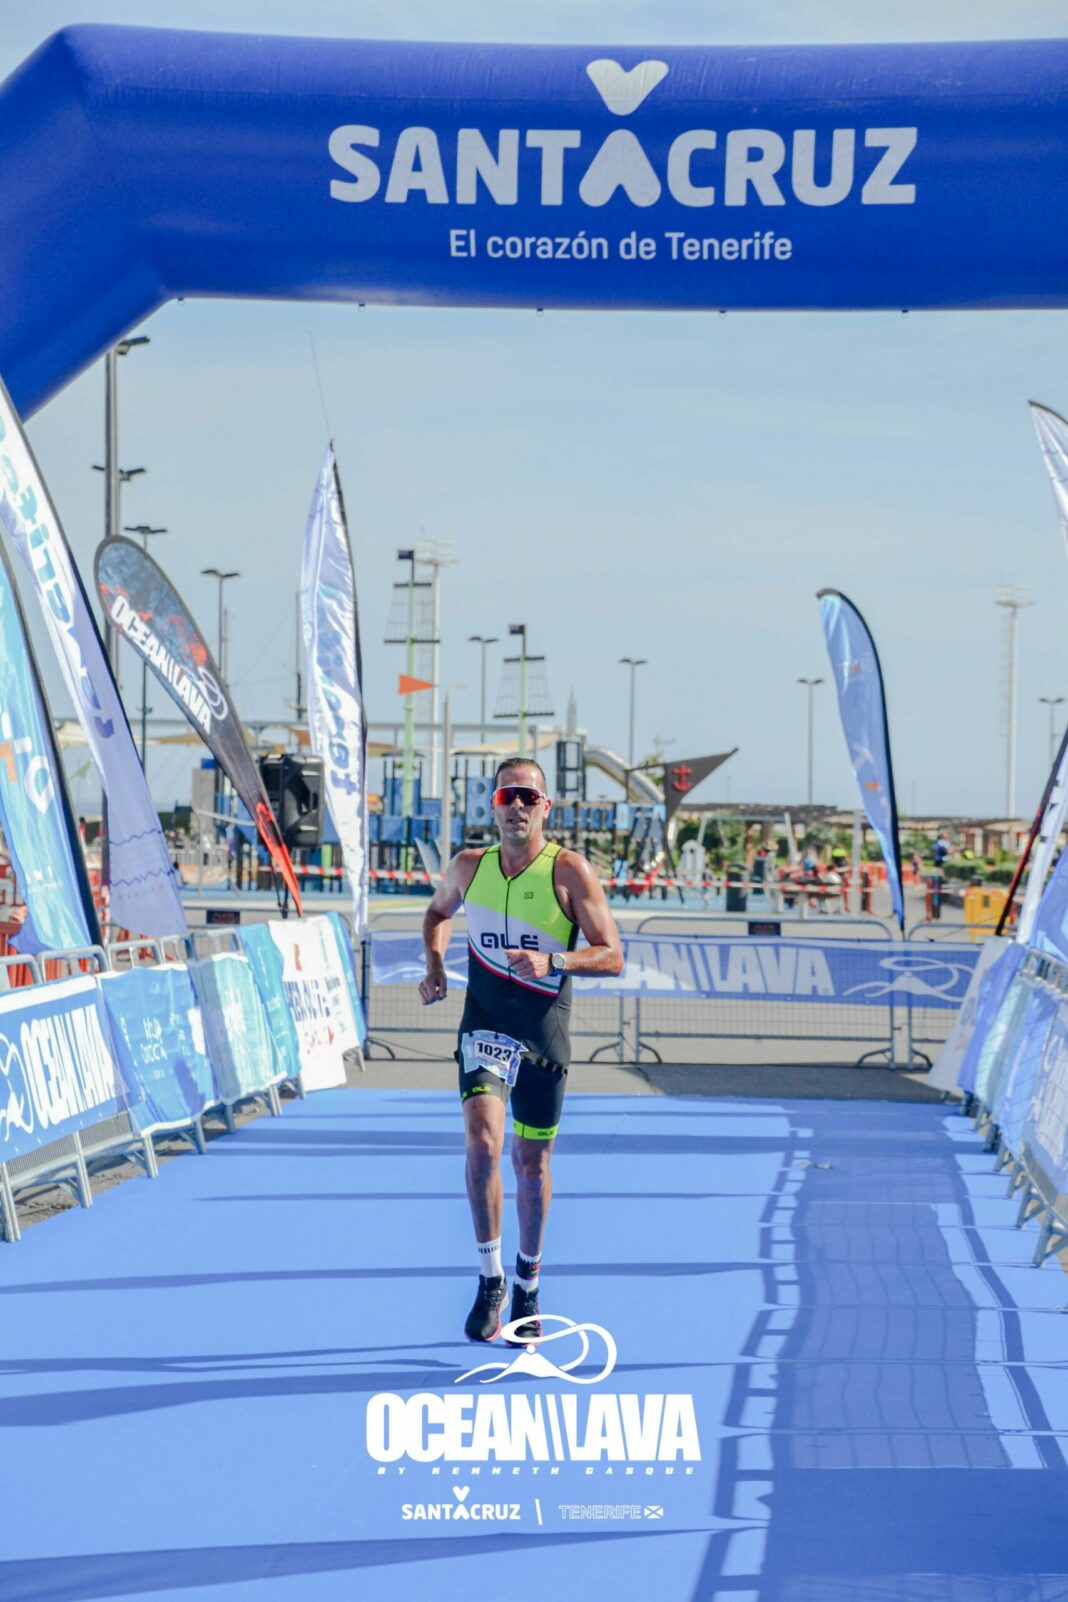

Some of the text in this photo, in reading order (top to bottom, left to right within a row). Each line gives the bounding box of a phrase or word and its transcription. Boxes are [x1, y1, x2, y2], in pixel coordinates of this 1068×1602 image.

[450, 229, 793, 260] El corazón de Tenerife
[477, 1042, 513, 1062] 1023
